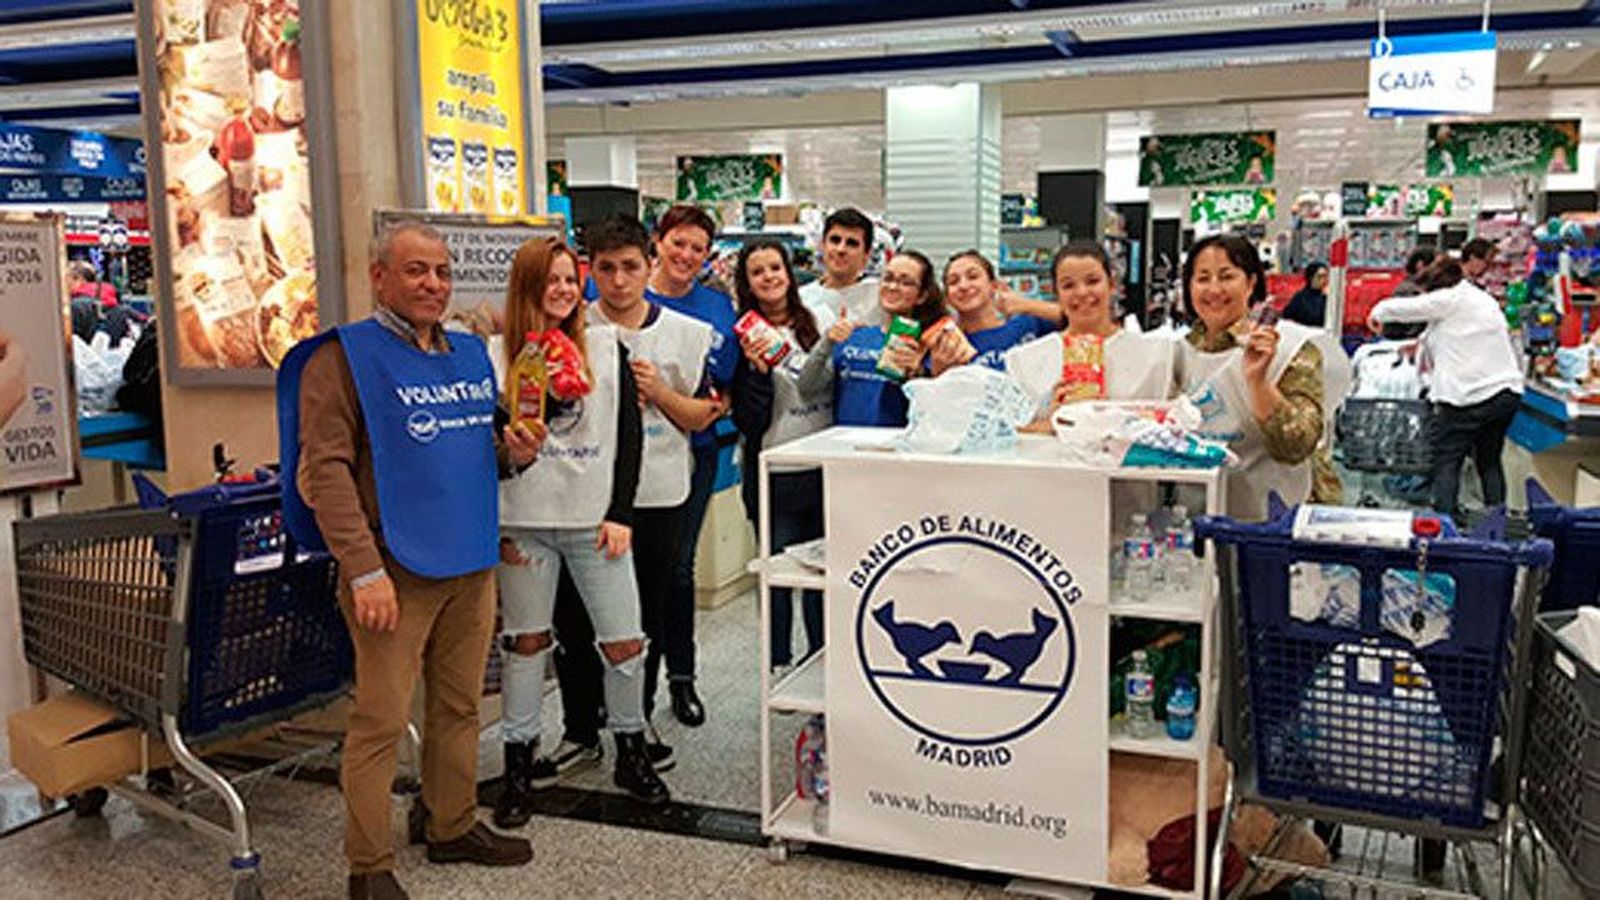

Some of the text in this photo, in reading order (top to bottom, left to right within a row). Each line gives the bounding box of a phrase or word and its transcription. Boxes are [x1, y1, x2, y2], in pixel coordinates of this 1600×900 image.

[496, 8, 508, 42] 3
[447, 69, 496, 95] amplia
[1378, 71, 1435, 92] CAJA
[437, 100, 508, 128] su familia
[6, 268, 43, 284] 2016
[5, 441, 57, 463] VIDA
[849, 515, 1083, 606] BANCO DE ALIMENTOS
[915, 738, 1013, 768] MADRID
[868, 788, 1067, 838] www.bamadrid.org
